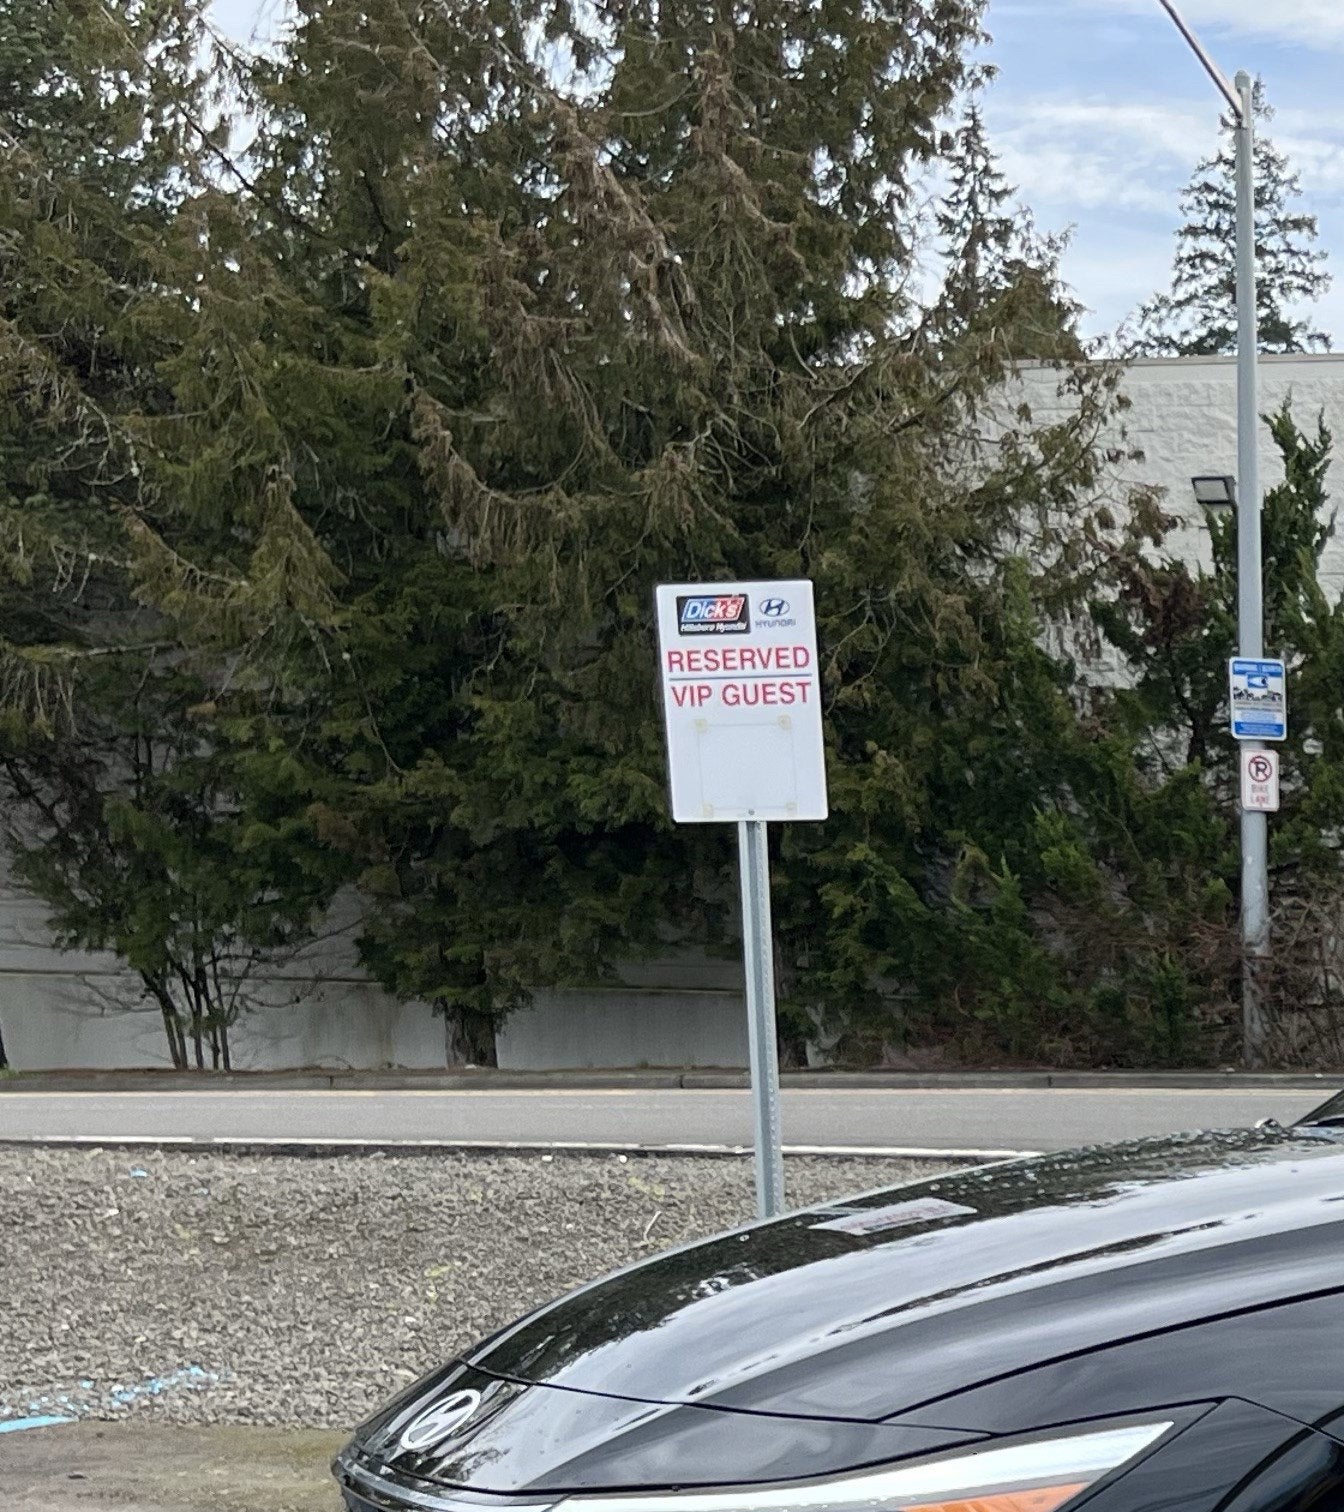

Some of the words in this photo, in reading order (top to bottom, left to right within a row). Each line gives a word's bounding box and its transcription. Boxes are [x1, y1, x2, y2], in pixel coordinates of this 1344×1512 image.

[667, 645, 811, 673] RESERVED
[671, 684, 712, 708] VIP
[721, 681, 812, 707] GUEST
